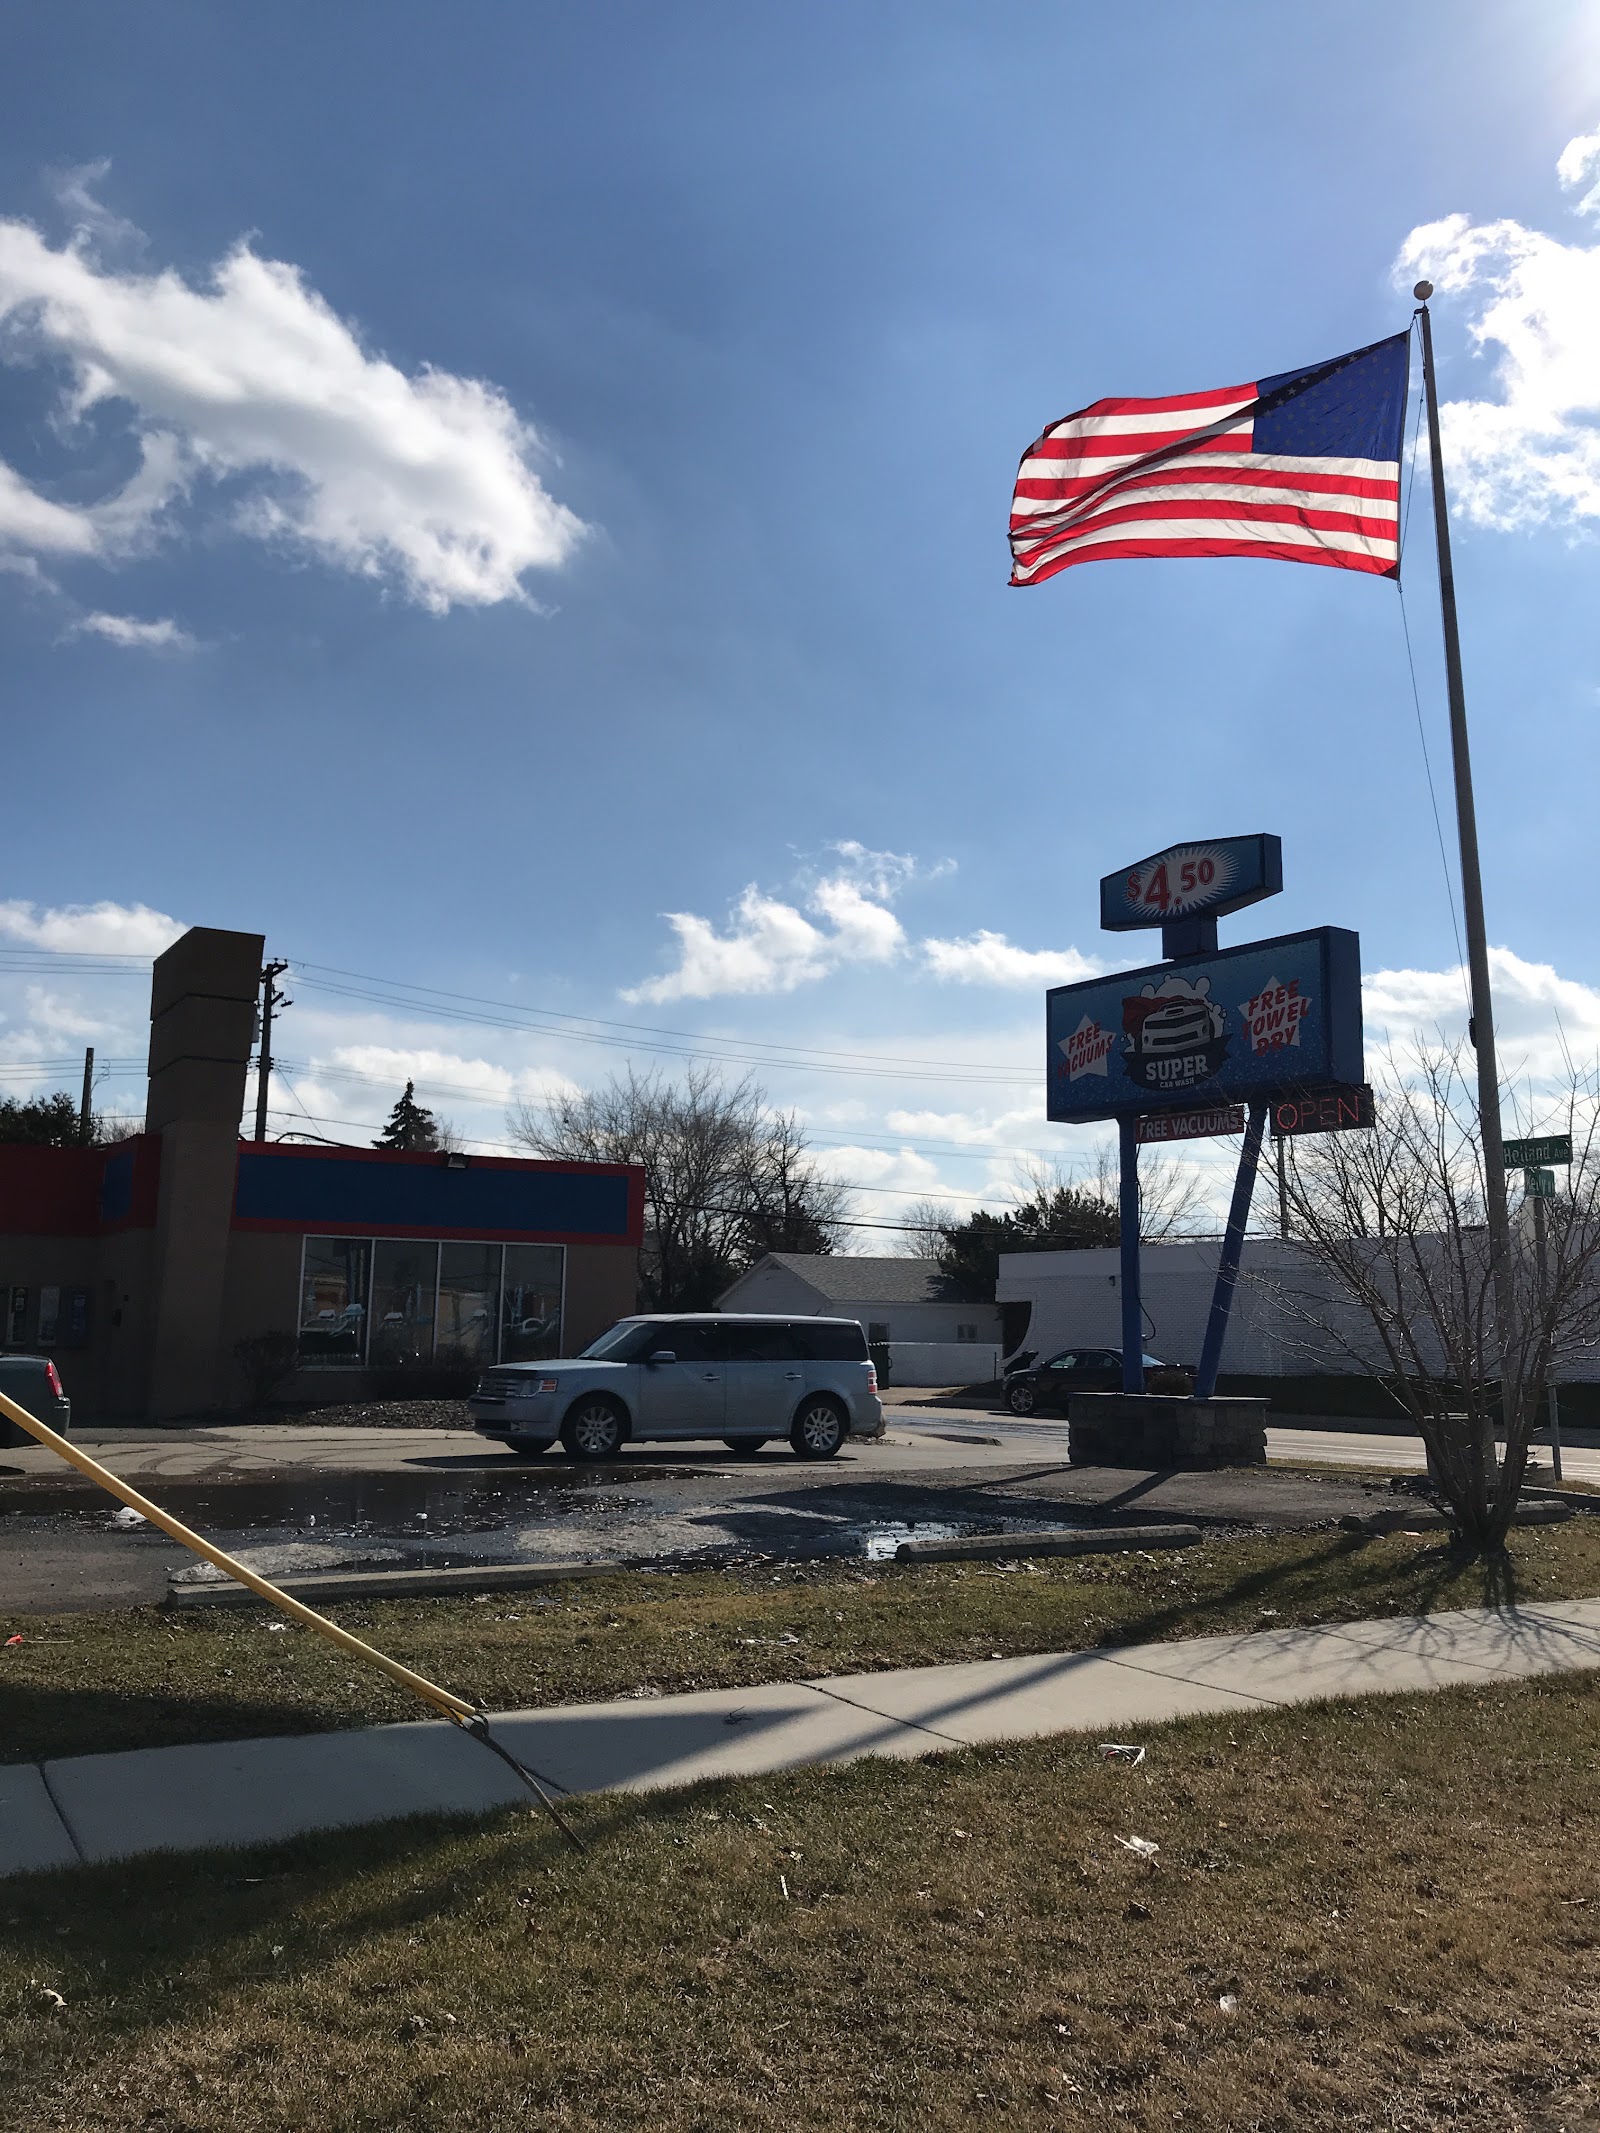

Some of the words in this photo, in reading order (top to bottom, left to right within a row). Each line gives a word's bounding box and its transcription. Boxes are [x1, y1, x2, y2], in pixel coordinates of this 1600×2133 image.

[1248, 978, 1300, 1016] FREE
[1242, 998, 1309, 1041] TOWEL
[1068, 1020, 1101, 1054] FREE
[1256, 1025, 1297, 1056] DRY
[1058, 1034, 1113, 1082] VACUUMS
[1145, 1054, 1209, 1081] SUPER
[1175, 1077, 1195, 1087] WASH
[1139, 1118, 1168, 1139] FREE
[1171, 1112, 1239, 1136] VACUUMS
[1276, 1095, 1360, 1130] OPEN
[1554, 1148, 1569, 1159] Ave
